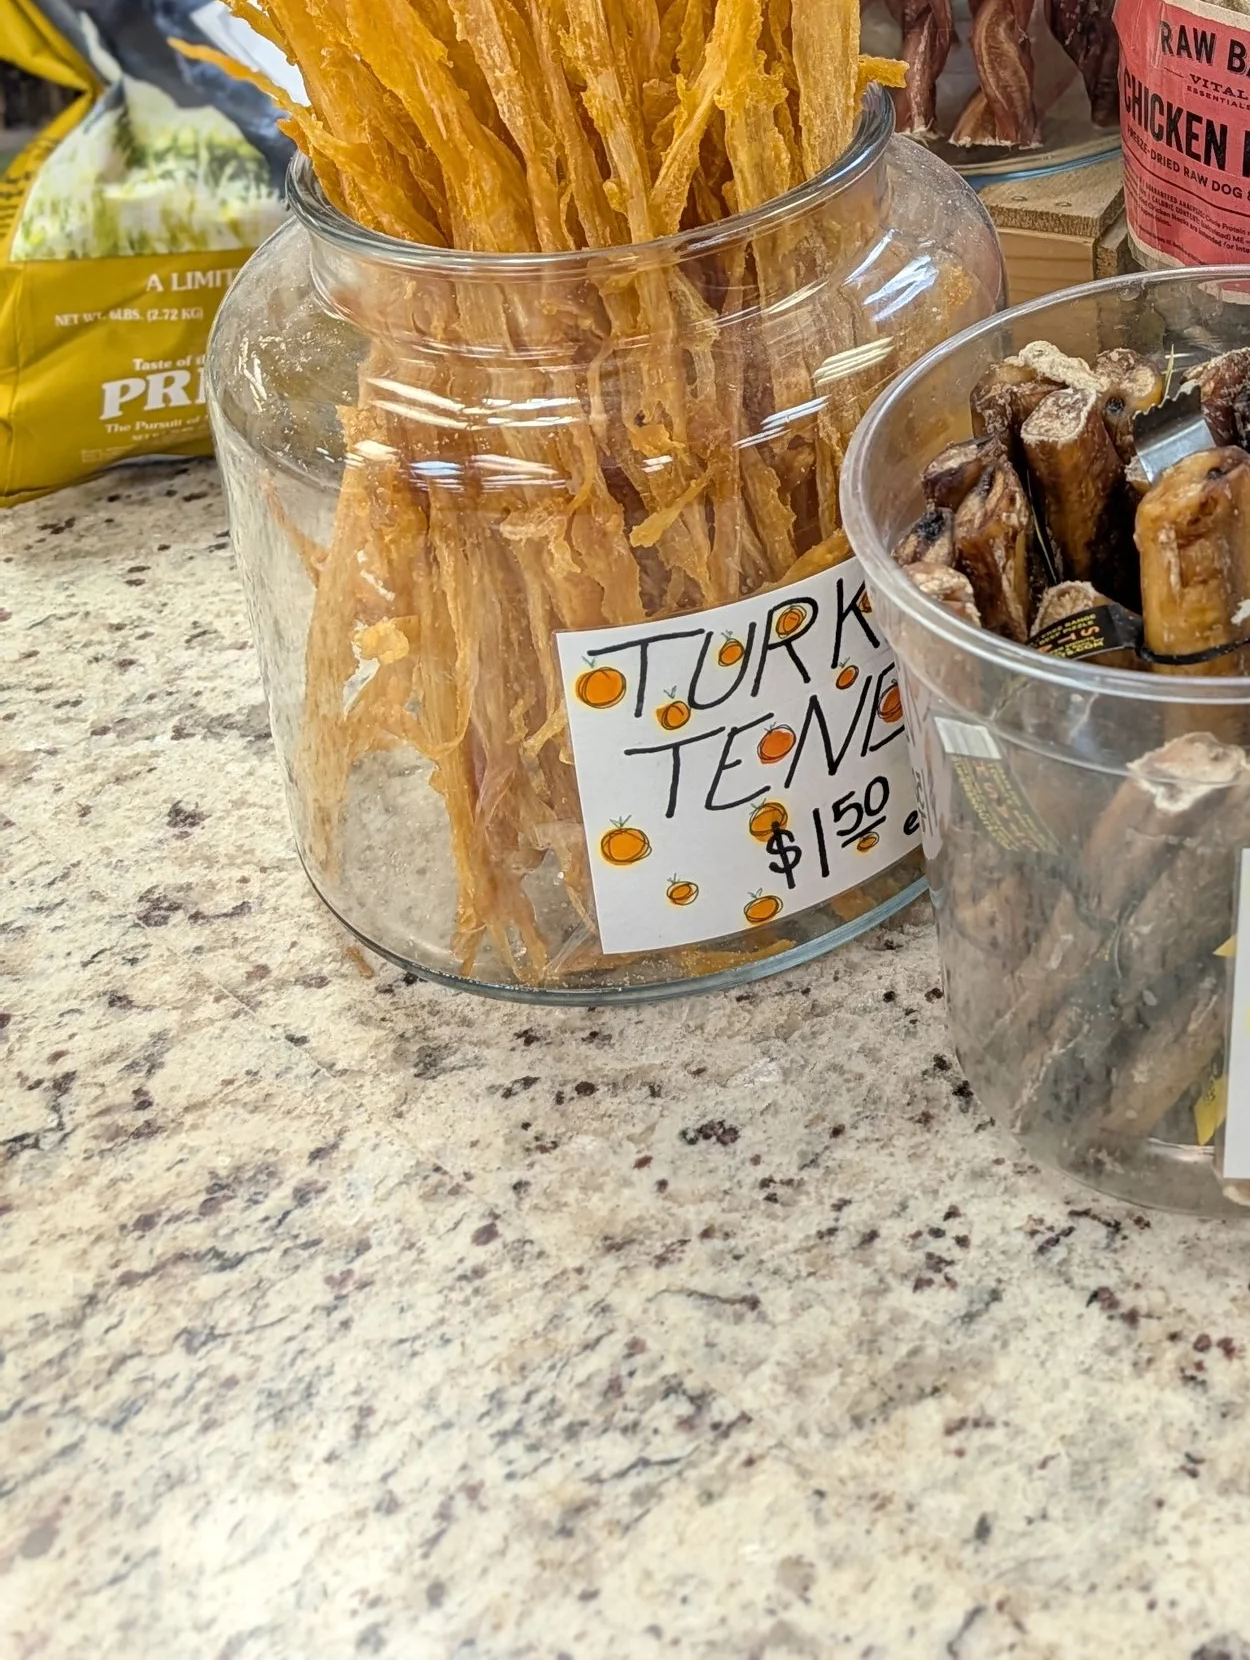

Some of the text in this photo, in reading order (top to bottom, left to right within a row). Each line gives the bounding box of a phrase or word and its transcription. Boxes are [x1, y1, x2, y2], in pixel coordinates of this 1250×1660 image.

[1160, 20, 1217, 67] RAW
[1189, 73, 1249, 101] VITAL
[1122, 67, 1228, 171] CHICKEN
[1127, 123, 1180, 173] FREEZE-DRIED
[1183, 165, 1208, 187] RAW
[1212, 180, 1243, 199] DOG
[146, 274, 165, 292] A
[133, 355, 193, 372] Taste of
[99, 368, 208, 421] PR
